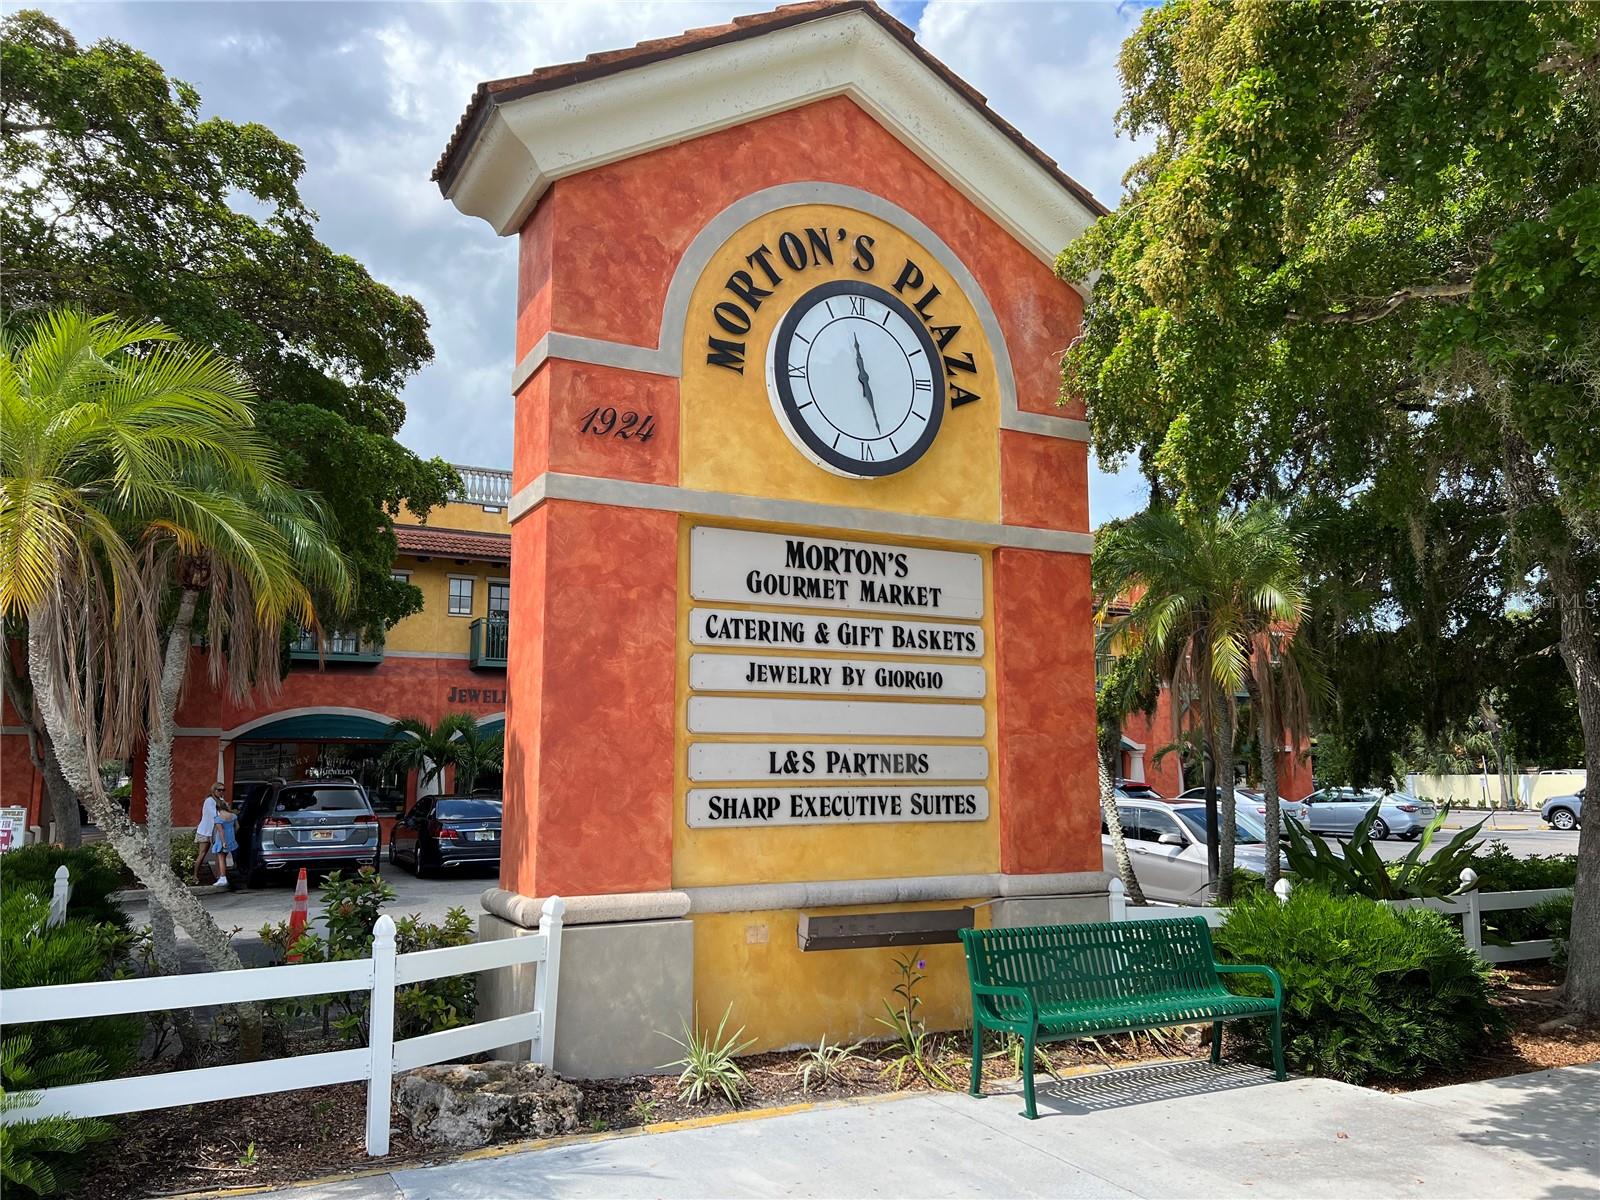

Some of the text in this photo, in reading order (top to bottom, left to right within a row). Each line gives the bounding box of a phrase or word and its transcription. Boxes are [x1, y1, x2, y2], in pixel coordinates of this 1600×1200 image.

[706, 227, 982, 410] MORTON'S PLAZA
[849, 295, 866, 317] XII
[915, 379, 932, 393] III
[580, 407, 656, 443] 1924
[784, 540, 909, 578] MORTON'S
[746, 570, 942, 608] GOURMET MARKET
[705, 614, 976, 652] CATERING & GIFT BASKETS
[745, 662, 943, 690] JEWELRY BY GIORGIO
[769, 750, 929, 776] L&S PARTNERS
[708, 792, 977, 821] SHARP EXECUTIVE SUITES
